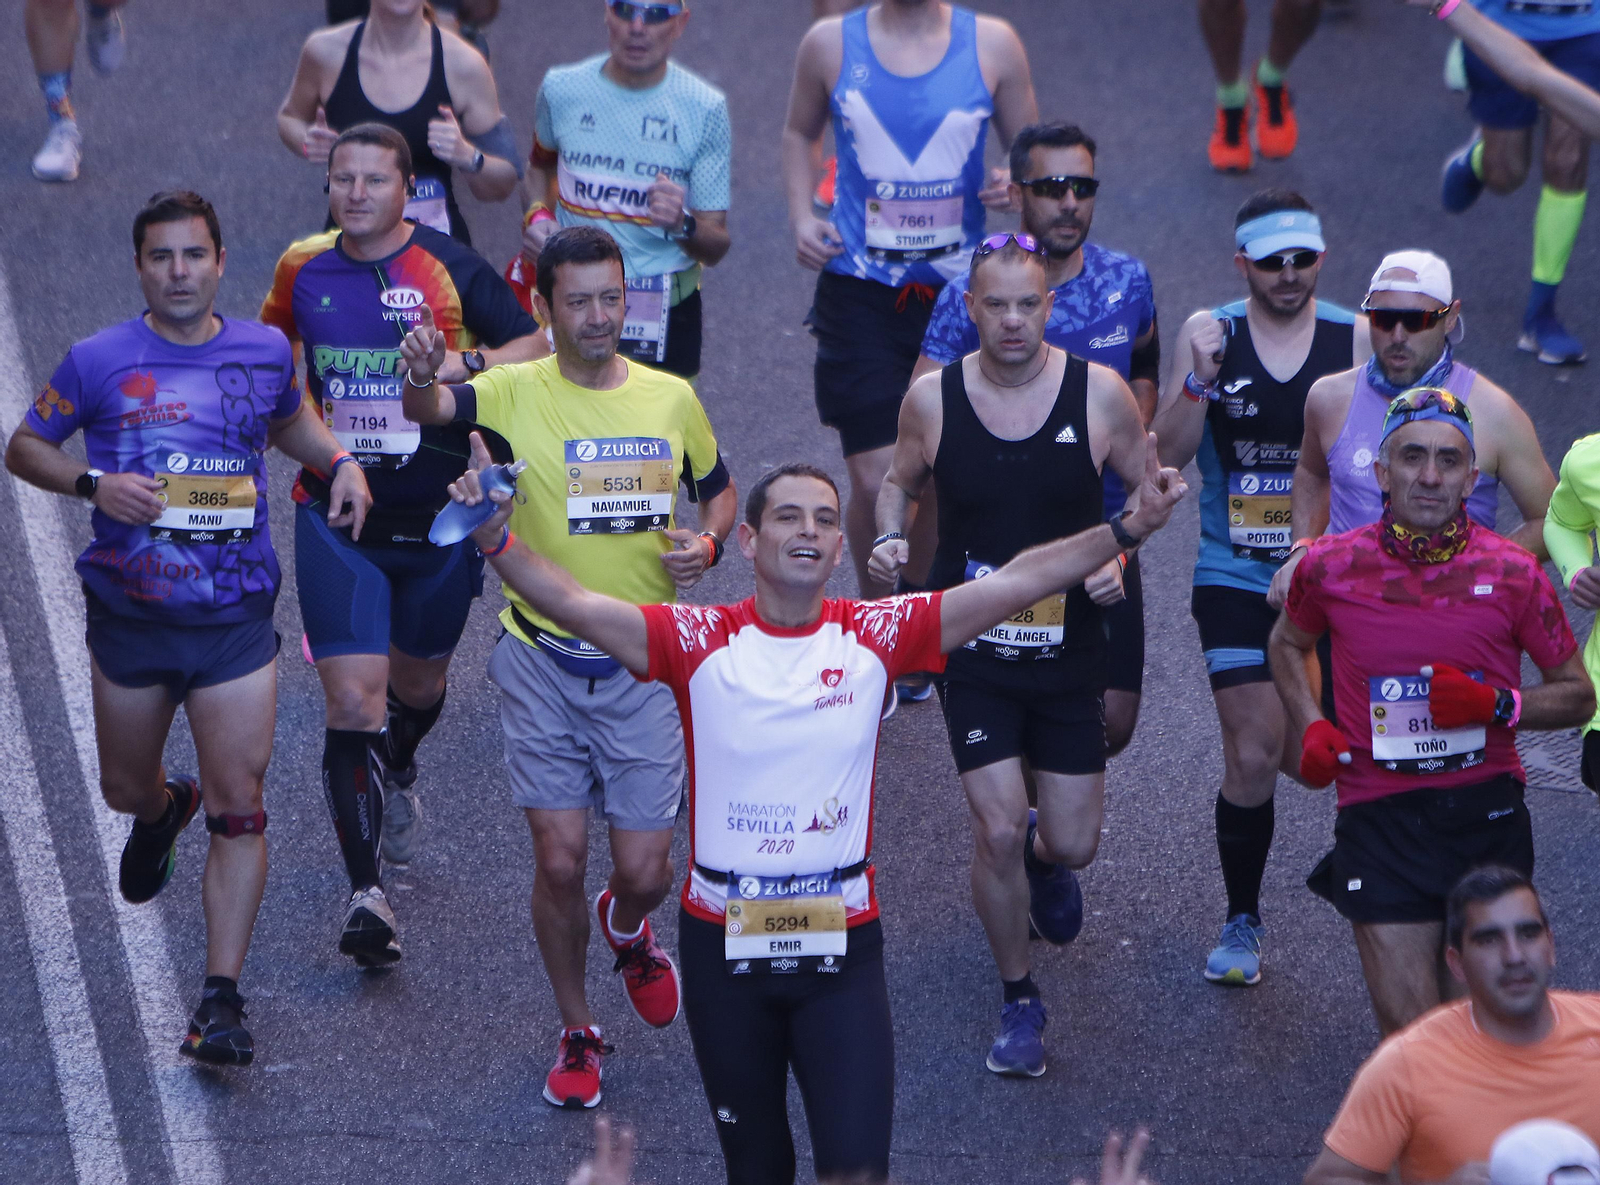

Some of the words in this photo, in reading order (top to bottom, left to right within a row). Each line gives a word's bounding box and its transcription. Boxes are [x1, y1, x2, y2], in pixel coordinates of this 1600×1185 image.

[413, 184, 434, 199] CH
[574, 180, 651, 207] RUFIN
[899, 184, 952, 198] ZURICH
[899, 215, 934, 227] 7661
[896, 235, 936, 246] STUART
[387, 293, 417, 304] KIA
[382, 312, 421, 321] VEYSER
[621, 326, 645, 336] 412
[350, 416, 388, 430] 7194
[355, 438, 382, 449] LOLO
[601, 443, 659, 457] ZURICH
[192, 458, 245, 472] ZURICH
[603, 477, 642, 492] 5531
[188, 491, 229, 506] 3865
[591, 500, 652, 513] NAVAMUEL
[188, 514, 222, 526] MANU
[1247, 533, 1284, 543] POTRO
[1008, 610, 1034, 623] 28
[1014, 629, 1052, 642] ÁNGEL
[1414, 738, 1447, 753] TOÑO
[728, 802, 796, 818] MARATÓN
[727, 817, 795, 834] SEVILLA
[757, 839, 795, 854] 2020
[764, 880, 828, 896] ZURICH
[765, 916, 809, 932] 5294
[769, 941, 802, 953] EMIR
